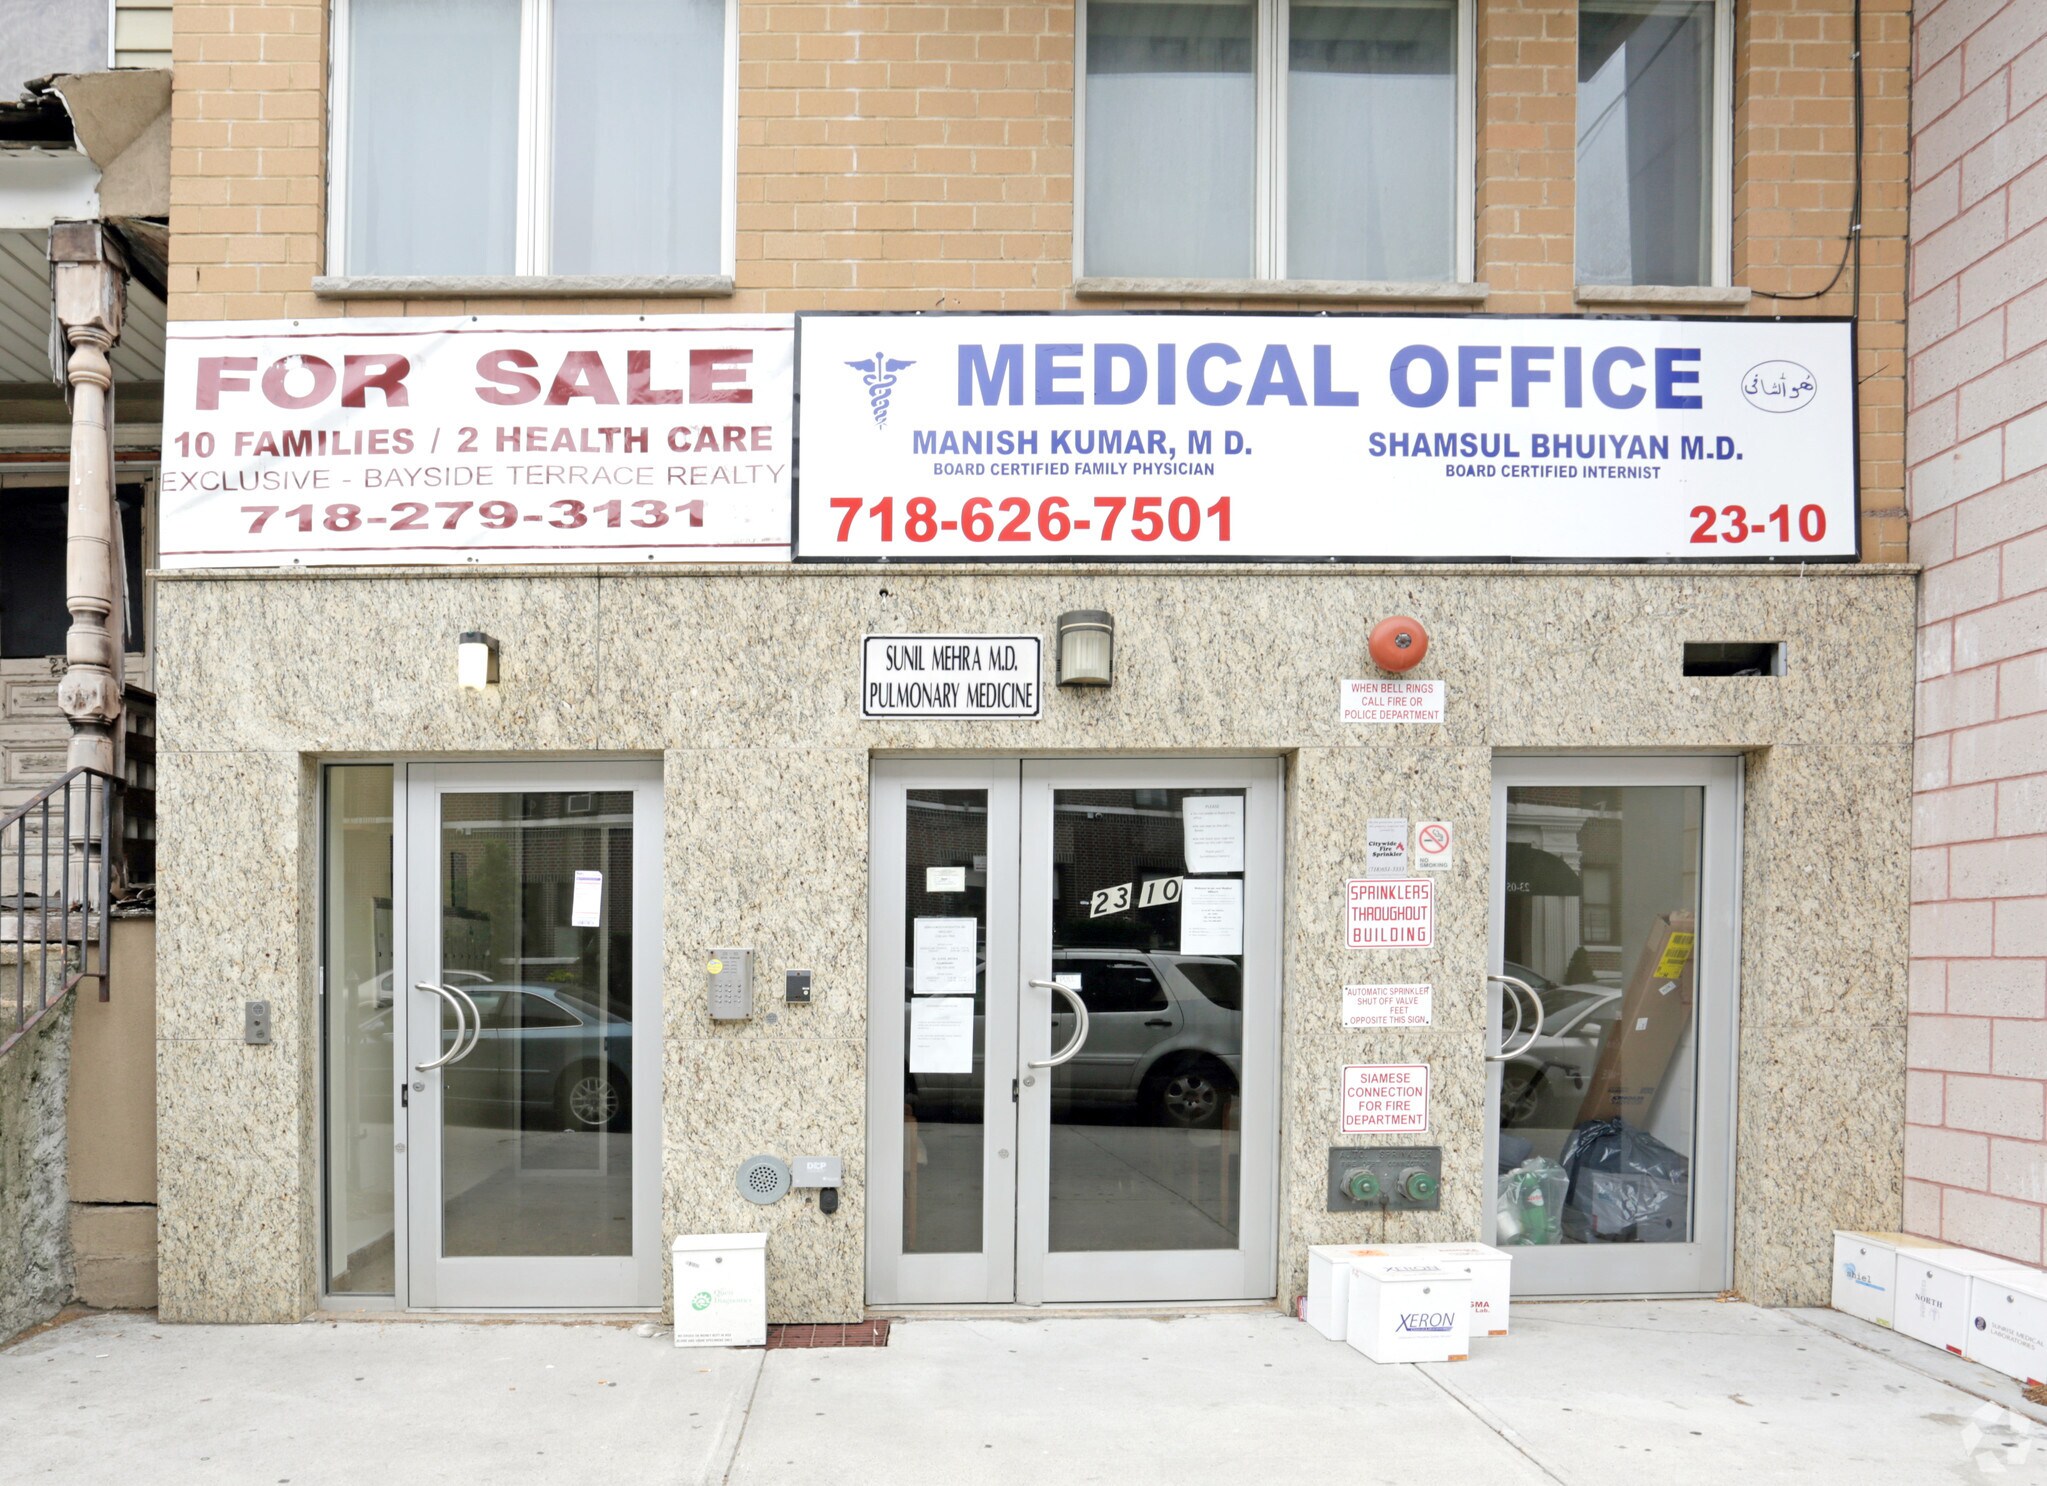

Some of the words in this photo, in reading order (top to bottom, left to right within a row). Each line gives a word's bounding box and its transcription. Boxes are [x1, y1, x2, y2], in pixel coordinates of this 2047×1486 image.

[195, 353, 410, 411] FOR
[475, 349, 754, 406] SALE
[957, 342, 1359, 407] MEDICAL
[1389, 343, 1703, 410] OFFICE
[174, 430, 216, 459] 10
[234, 428, 415, 457] FAMILIES
[430, 427, 441, 455] /
[457, 426, 479, 453] 2
[496, 426, 650, 454] HEALTH
[667, 426, 773, 453] CARE
[913, 430, 1039, 456] MANISH
[1051, 430, 1177, 460] KUMAR,
[1368, 431, 1520, 459] SHAMSUL
[1531, 433, 1670, 460] BHUIYAN
[1681, 435, 1744, 461] M.D.
[933, 462, 986, 477] BOARD
[990, 462, 1070, 477] CERTIFIED
[1074, 462, 1128, 476] FAMILY
[1132, 462, 1215, 477] PHYSICIAN
[1445, 465, 1496, 479] BOARD
[1501, 465, 1579, 479] CERTIFIED
[1582, 466, 1662, 480] INTERNIST
[161, 470, 331, 493] EXCLUSIVE
[365, 466, 493, 489] BAYSIDE
[507, 465, 655, 487] TERRACE
[667, 464, 786, 486] REALTY
[240, 499, 706, 535] 718-279-3131
[829, 496, 1232, 543] 718-626-7501
[1688, 504, 1828, 545] 23-10
[886, 645, 925, 671] SUNIL
[931, 645, 982, 671] MEHRA
[988, 645, 1018, 671] M.D.
[869, 682, 960, 708] PULMONARY
[966, 682, 1033, 708] MEDICINE
[1351, 683, 1378, 693] WHEN
[1381, 683, 1404, 693] BELL
[1406, 683, 1434, 693] RINGS
[1361, 696, 1385, 706] CALL
[1387, 696, 1407, 706] FIRE
[1409, 696, 1423, 706] OR
[1344, 710, 1377, 720] POLICE
[1379, 710, 1440, 720] DEPARTMENT
[1093, 887, 1128, 914] 23
[1148, 879, 1179, 904] 10
[1351, 884, 1429, 901] SPRINKLERS
[1351, 906, 1428, 922] THROUGHOUT
[1353, 927, 1426, 943] BUILDING
[1347, 988, 1388, 996] AUTOMATIC
[1389, 987, 1429, 995] SPRINKLER
[1357, 997, 1377, 1005] SHUT
[1379, 997, 1394, 1005] OFF
[1396, 997, 1419, 1005] VALVE
[1390, 1006, 1408, 1014] FEET
[1350, 1016, 1388, 1024] OPPOSITE
[1389, 1016, 1406, 1024] THIS
[1360, 1072, 1411, 1084] SIAMESE
[1347, 1086, 1423, 1098] CONNECTION
[1359, 1100, 1382, 1111] FOR
[1385, 1100, 1411, 1111] FIRE
[1346, 1114, 1423, 1125] DEPARTMENT
[1914, 1292, 1943, 1308] NORTH
[1396, 1312, 1455, 1332] XERON
[1990, 1329, 2036, 1351] LABORATORIES
[1991, 1321, 2015, 1335] SUNRISE
[2016, 1331, 2045, 1347] MEDICAL
